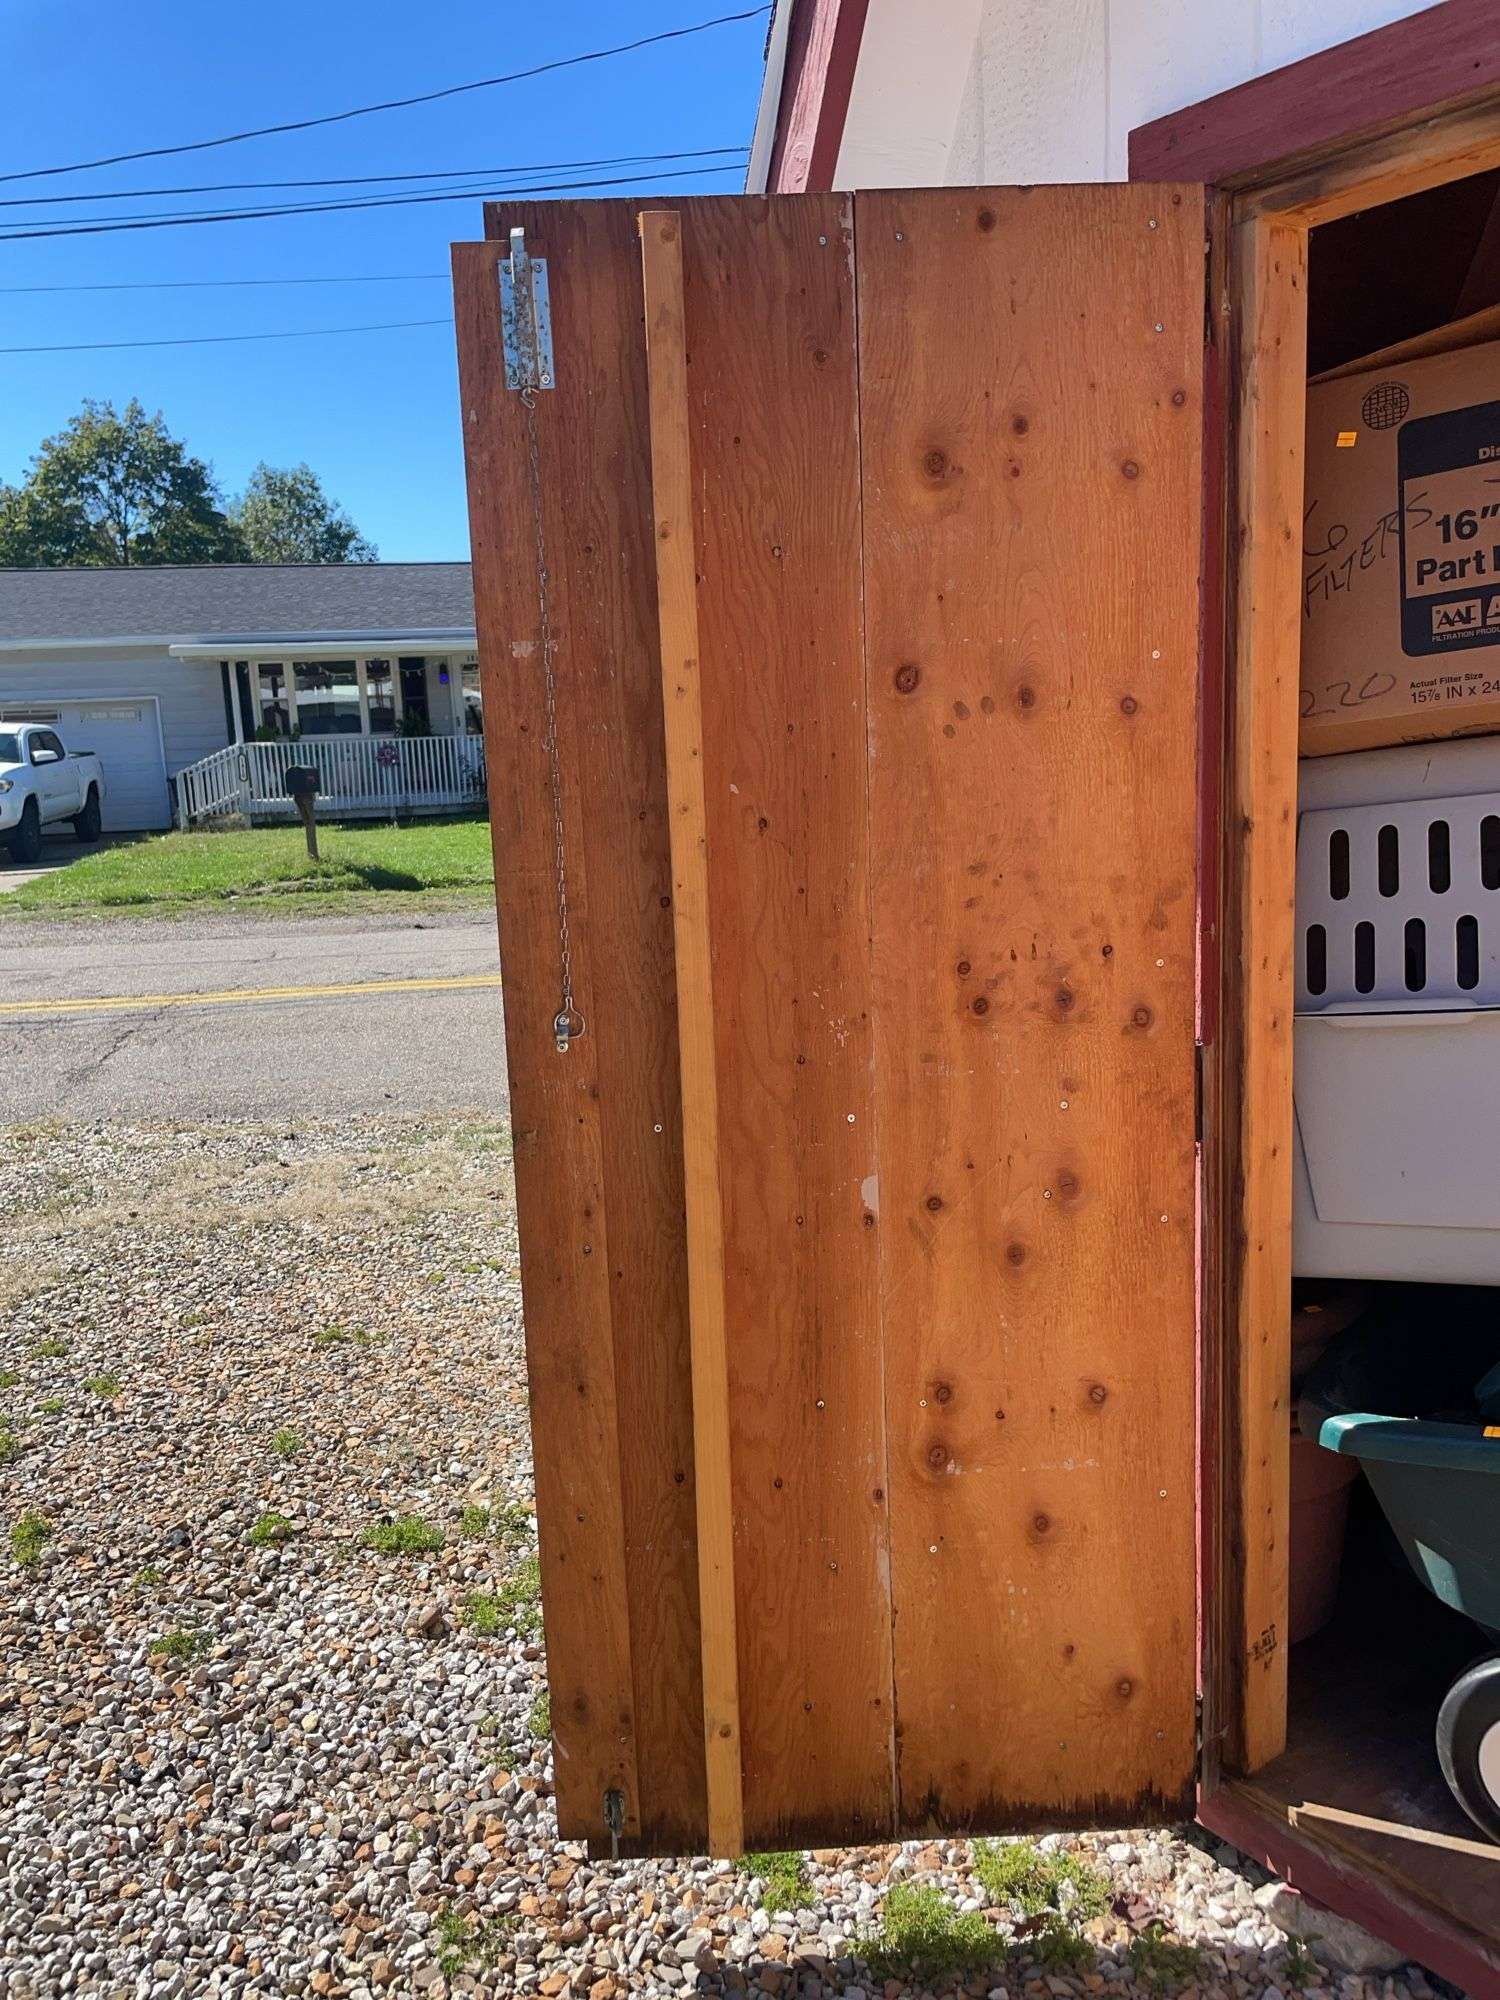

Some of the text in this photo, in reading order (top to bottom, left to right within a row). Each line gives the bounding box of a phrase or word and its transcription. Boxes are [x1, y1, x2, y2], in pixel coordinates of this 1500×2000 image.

[1304, 491, 1433, 619] FILTERS
[1416, 550, 1486, 586] Part
[1436, 604, 1477, 629] AAF
[1410, 673, 1484, 689] Actual Filter Size
[1446, 685, 1463, 699] IN
